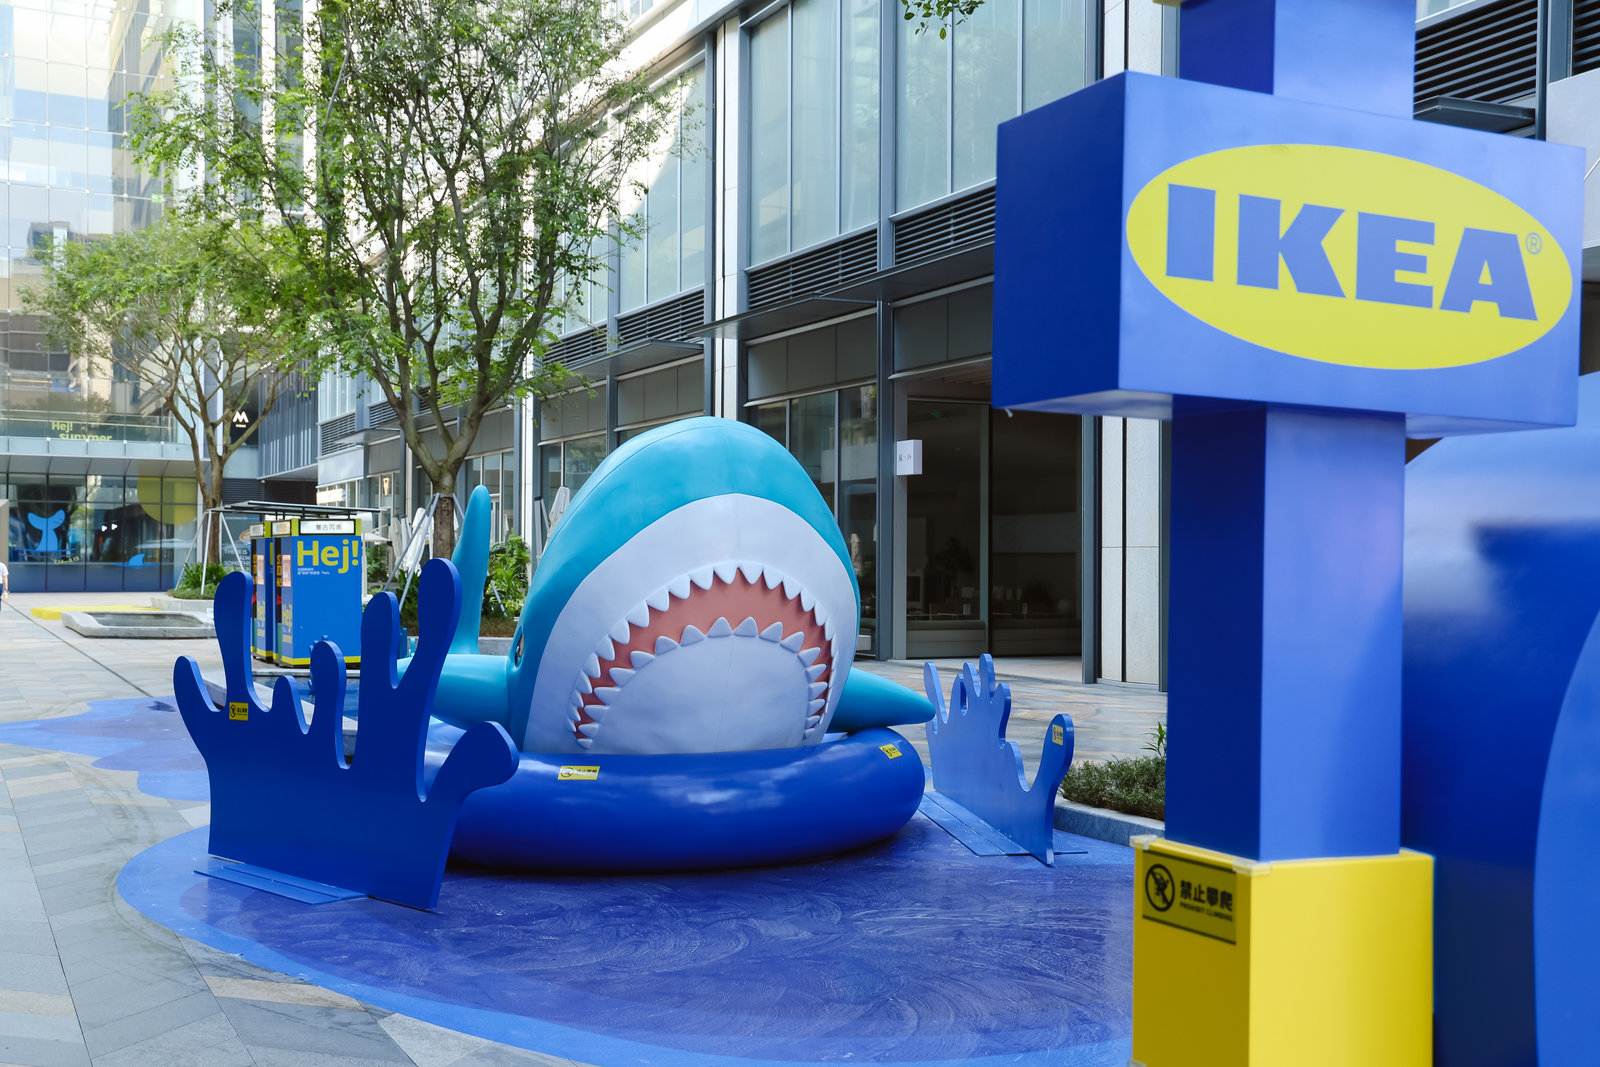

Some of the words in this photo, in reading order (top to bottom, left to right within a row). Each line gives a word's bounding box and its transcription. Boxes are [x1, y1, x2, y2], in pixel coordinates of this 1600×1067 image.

[51, 421, 73, 432] Hej!
[297, 539, 359, 574] Hej!
[1180, 880, 1233, 912] 禁止攀爬
